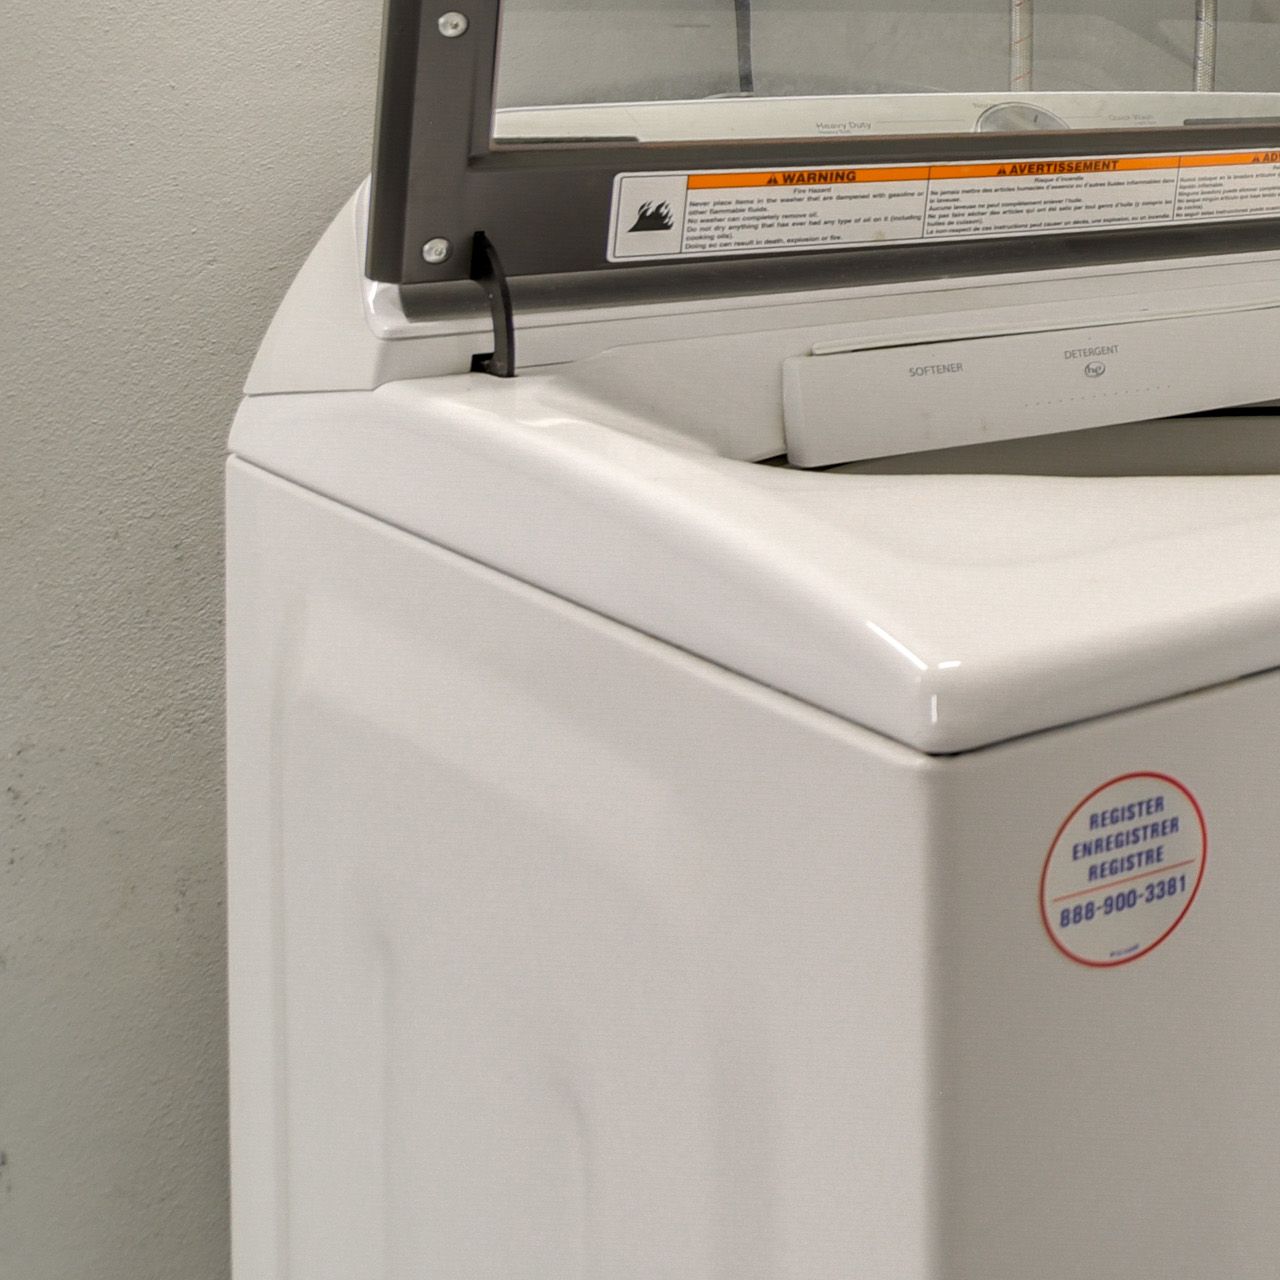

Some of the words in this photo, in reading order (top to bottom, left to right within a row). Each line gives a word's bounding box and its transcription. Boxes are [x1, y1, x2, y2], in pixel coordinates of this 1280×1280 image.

[782, 169, 857, 184] WARNING
[1009, 160, 1120, 176] AVERTISSEMENT
[1063, 344, 1120, 360] DETERGENT
[909, 361, 964, 378] SOFTENER
[1088, 795, 1165, 831] REGISTER
[1072, 816, 1180, 862] ENREGISTRER
[1088, 844, 1165, 882] REGISTRE
[1059, 873, 1187, 929] 888-900-3381
